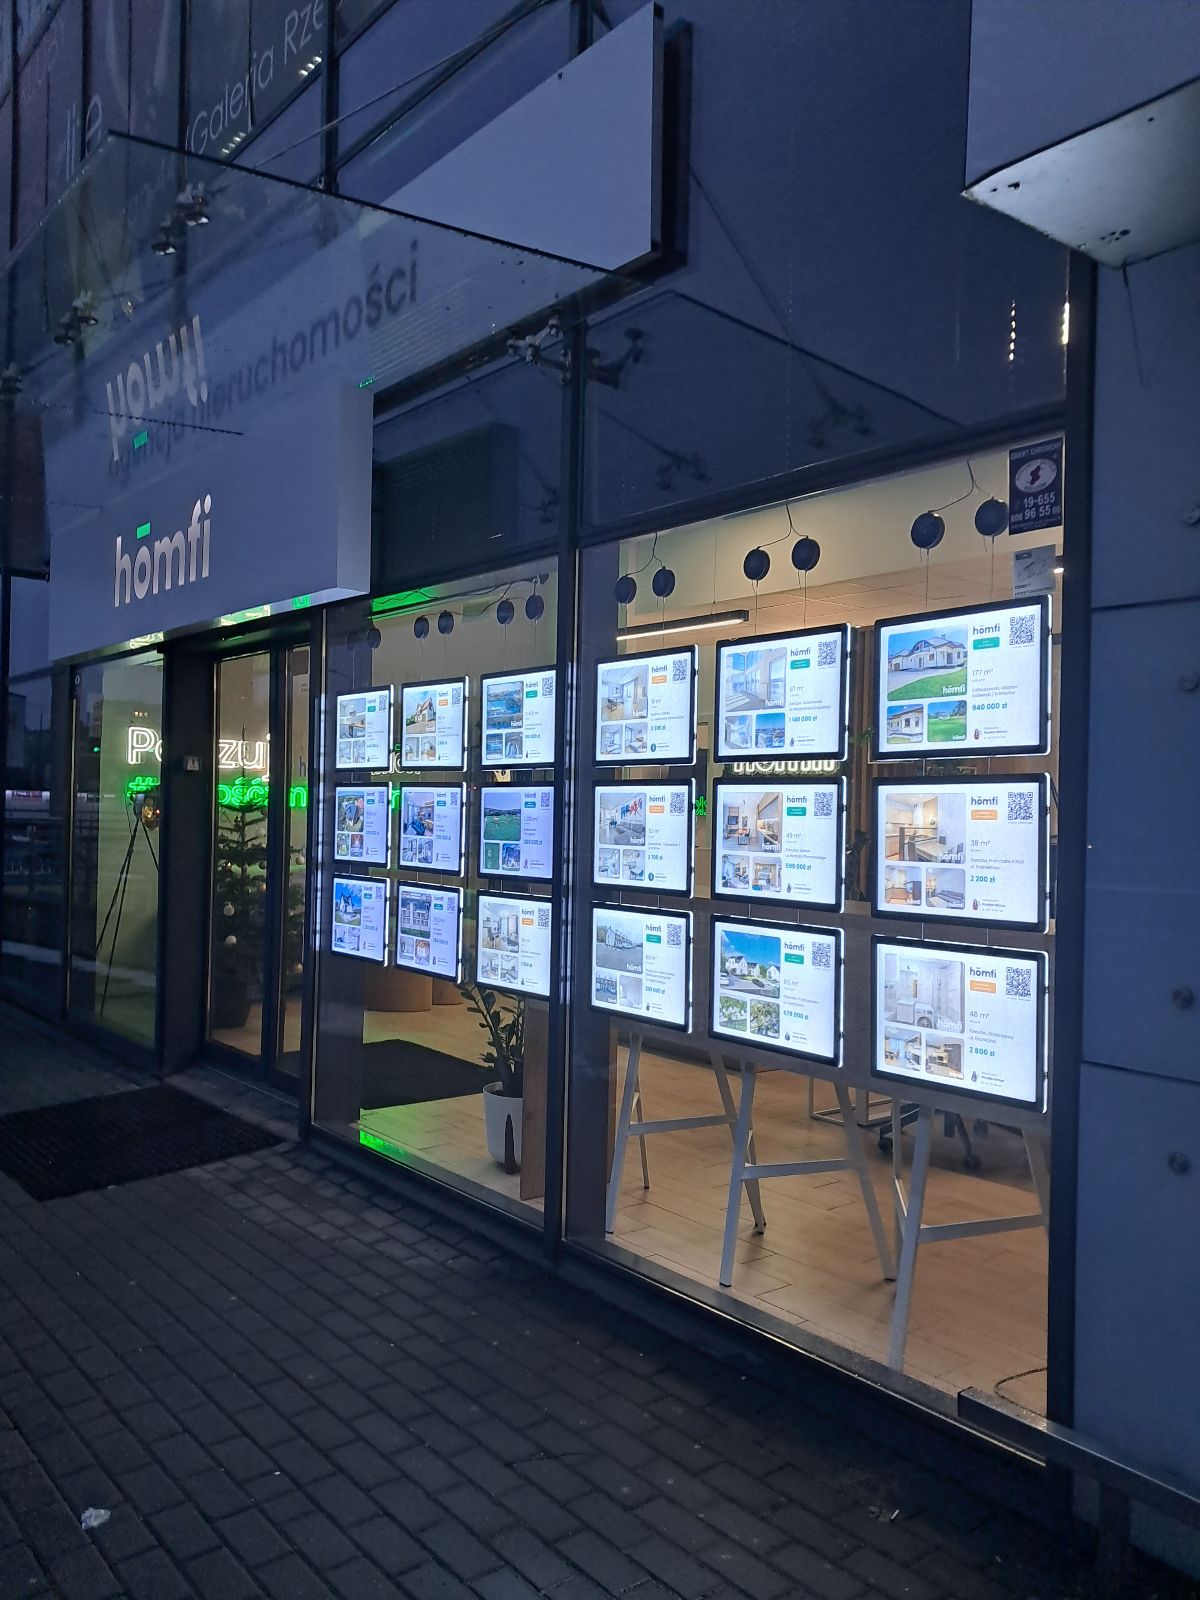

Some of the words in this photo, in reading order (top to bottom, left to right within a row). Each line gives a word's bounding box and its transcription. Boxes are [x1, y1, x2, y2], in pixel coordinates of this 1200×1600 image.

[1024, 491, 1056, 508] 19-655
[1024, 507, 1037, 520] 96
[1039, 504, 1051, 517] 55
[972, 703, 985, 711] 940
[986, 702, 1001, 710] 000
[1001, 701, 1008, 709] zł
[969, 1010, 979, 1018] 48
